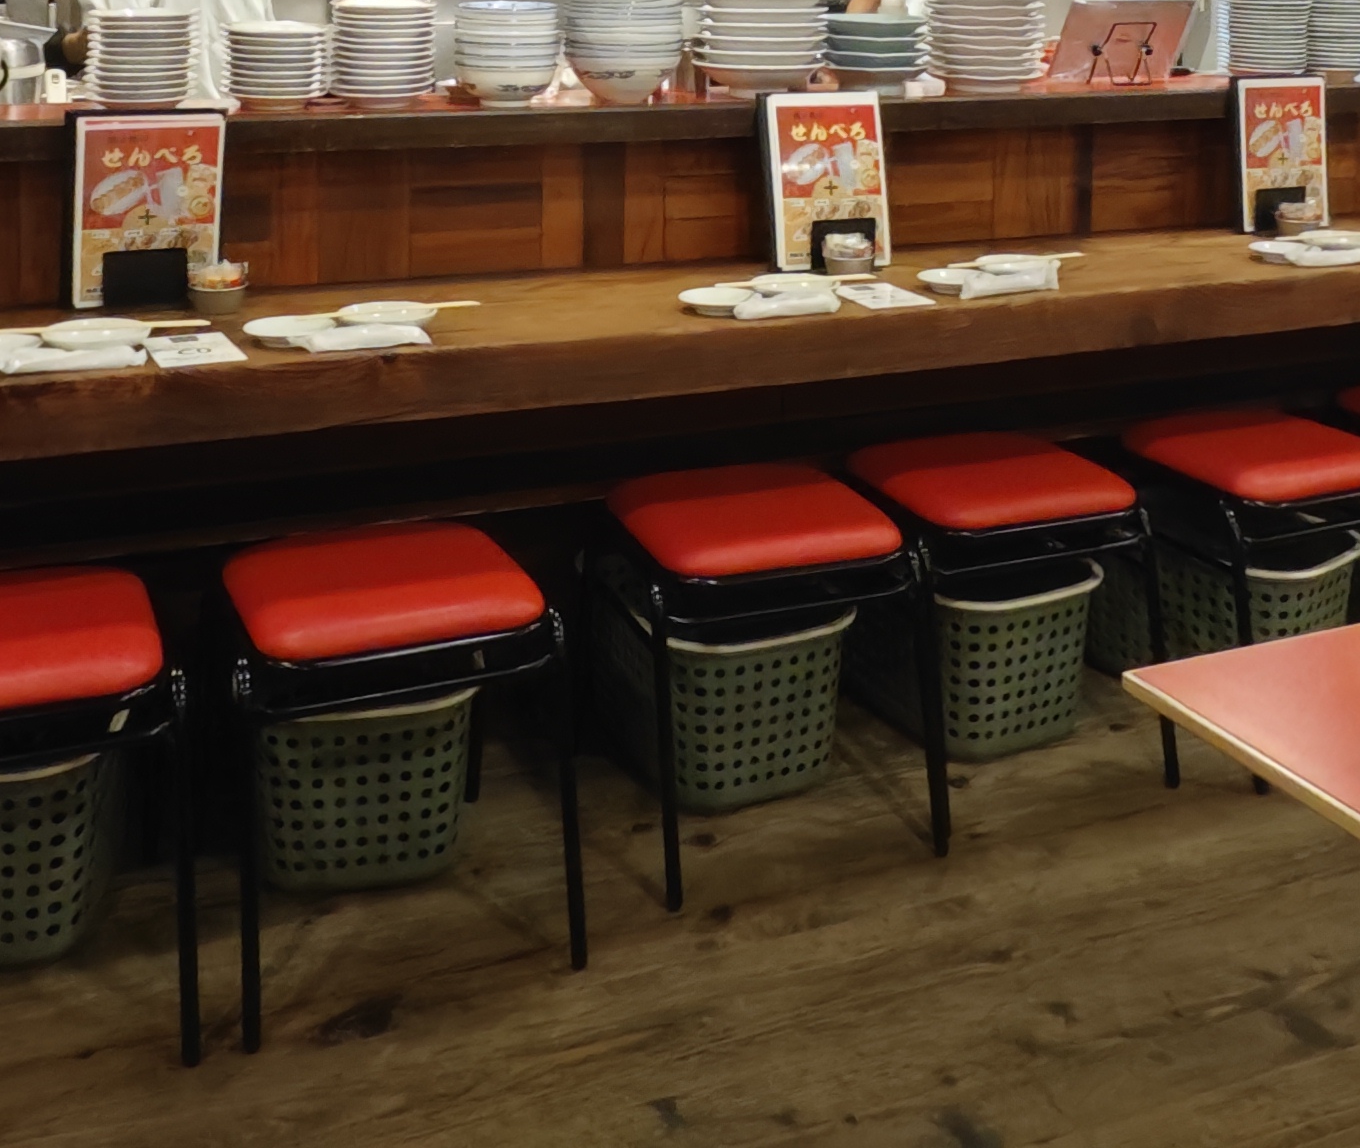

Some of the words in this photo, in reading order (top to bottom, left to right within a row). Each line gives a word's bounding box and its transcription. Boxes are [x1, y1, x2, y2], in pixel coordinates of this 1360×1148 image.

[1255, 100, 1313, 118] せんべろ
[791, 121, 865, 141] せんべろ
[102, 144, 202, 168] せんべろ
